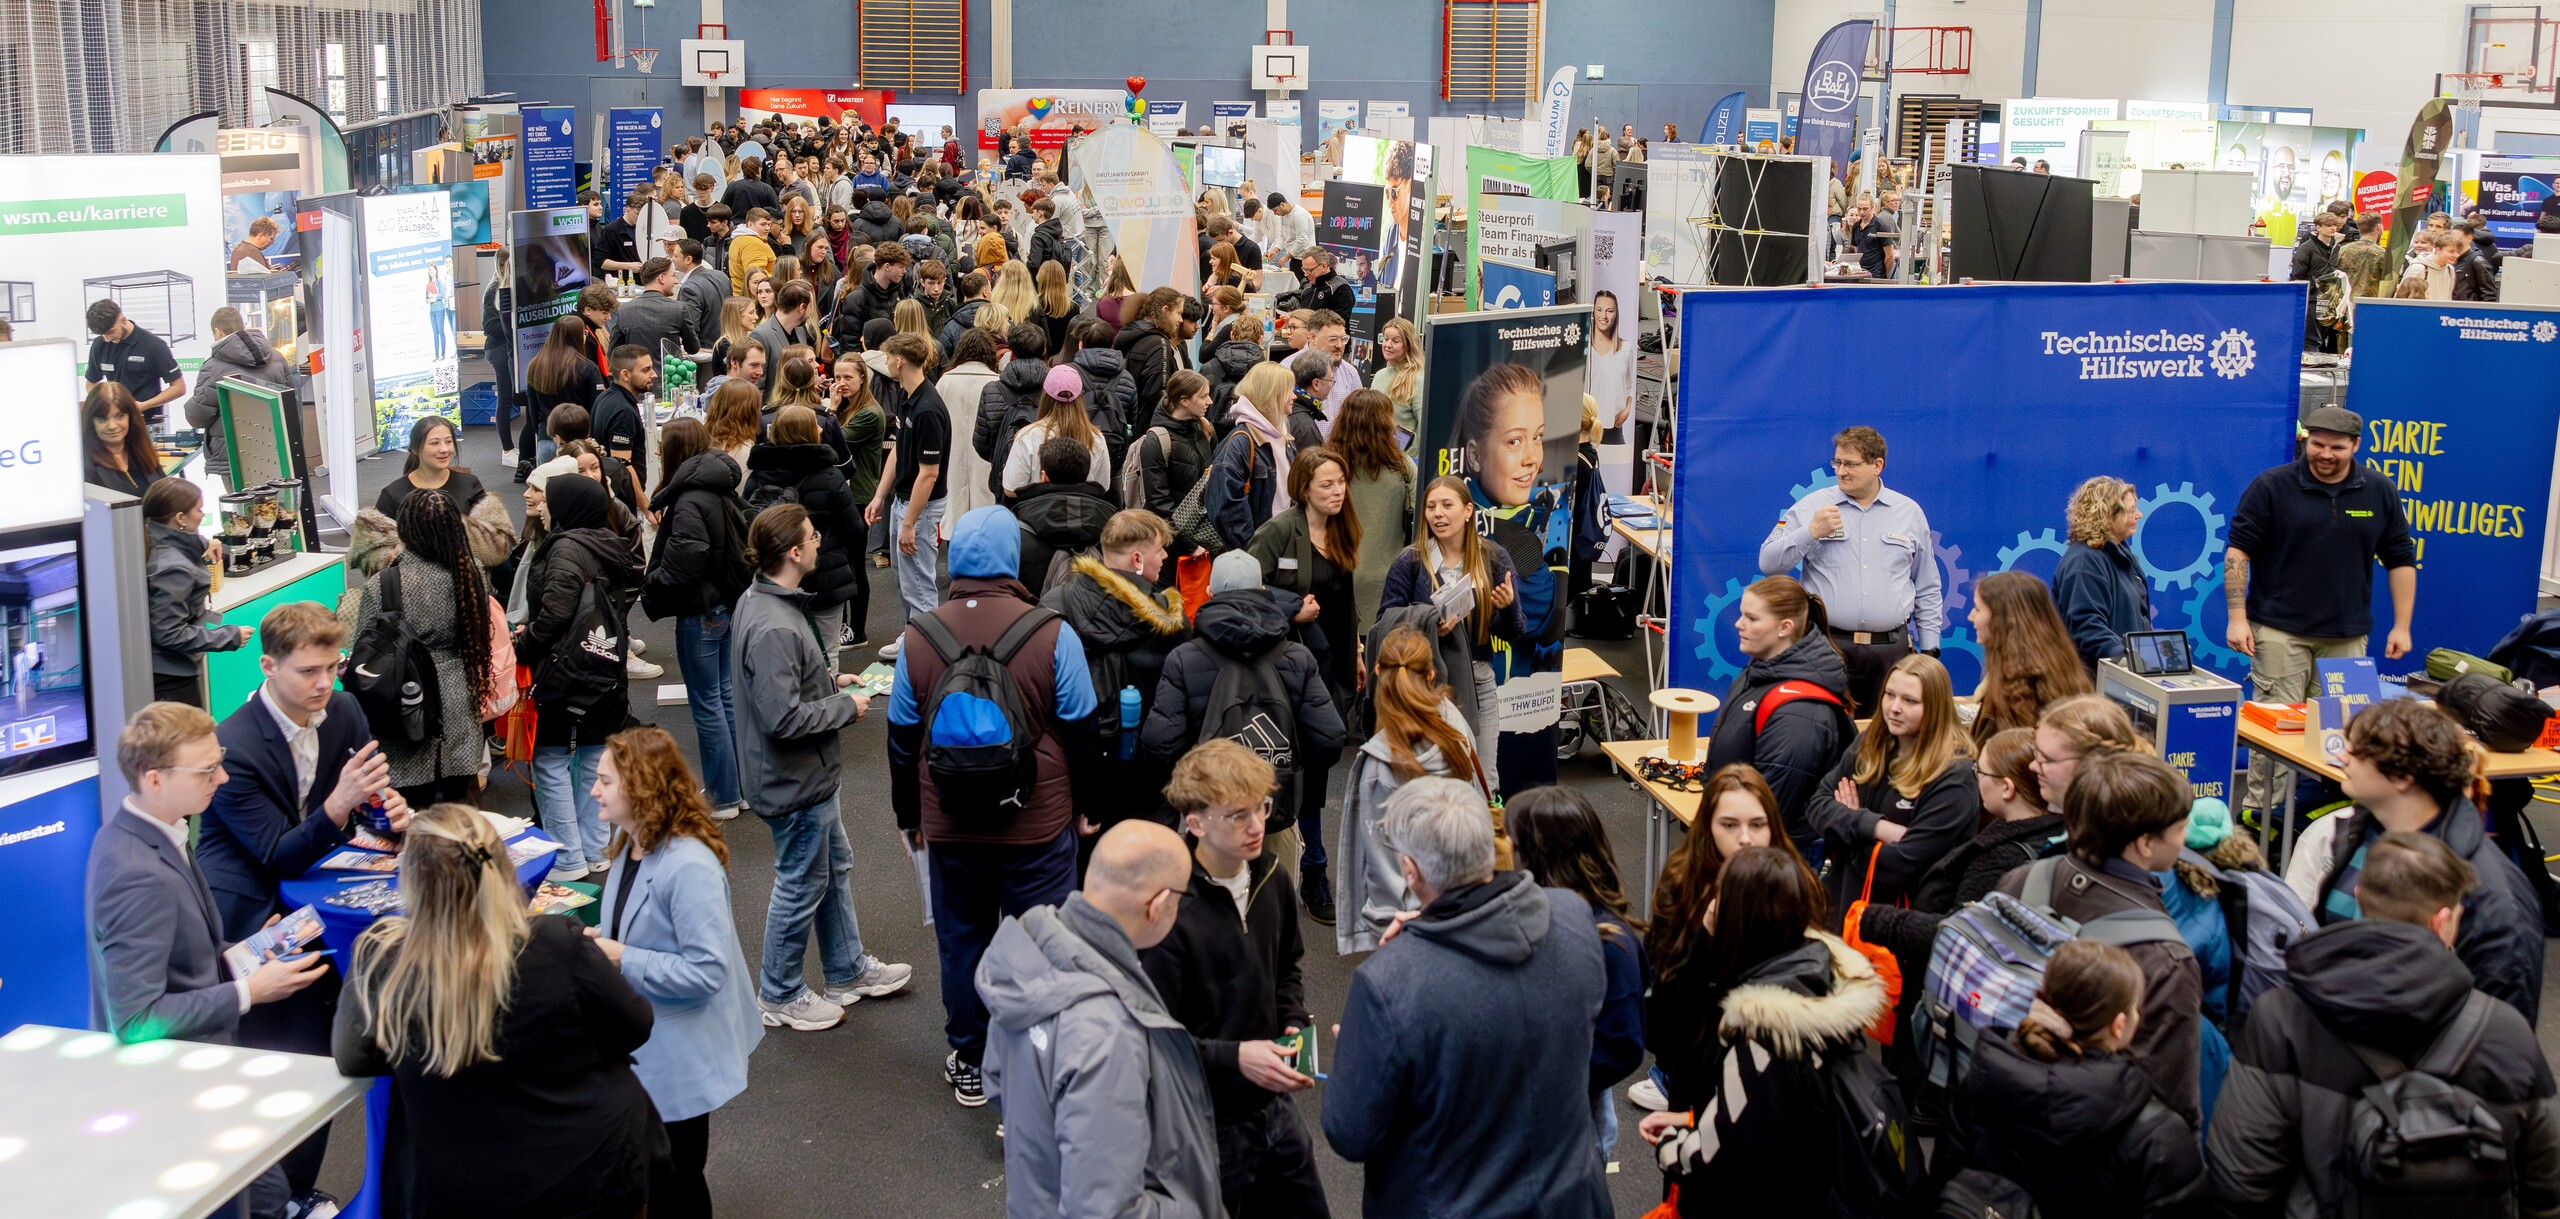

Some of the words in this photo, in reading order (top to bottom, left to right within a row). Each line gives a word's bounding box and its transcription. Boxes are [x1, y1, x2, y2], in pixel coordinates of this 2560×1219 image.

[1054, 98, 1120, 115] REINERY
[2013, 107, 2110, 116] ZUKUNFTSFORMER
[2131, 107, 2203, 120] ZUKUNFTSFORMER
[1547, 100, 1560, 159] EEBAUM
[1811, 118, 1825, 126] think
[1825, 119, 1850, 129] transport
[2013, 118, 2064, 126] GESUCHT!
[216, 132, 286, 152] BERG
[2357, 181, 2398, 196] AUSBILDUNG
[2481, 181, 2512, 192] Was
[2362, 192, 2395, 203] Physiotherapie
[2365, 200, 2394, 210] Ergotherapie
[3, 203, 168, 225] wsm.eu/karriere
[1478, 210, 1534, 227] Steuerprofi
[2492, 209, 2515, 217] Kampf
[452, 219, 472, 229] geben?
[558, 216, 582, 226] wsm
[1481, 226, 1508, 240] Team
[1481, 244, 1509, 256] mehr
[1511, 245, 1528, 258] als
[551, 298, 560, 306] mit
[560, 295, 577, 304] deiner
[518, 302, 578, 324] AUSBILDUNG
[2440, 315, 2530, 330] Technisches
[522, 330, 550, 341] Technisch
[1498, 325, 1561, 340] Technisches
[2459, 327, 2529, 342] Hilfswerk
[522, 341, 546, 351] System
[1512, 337, 1561, 351] Hilfswerk
[2041, 329, 2205, 354] Technisches
[2079, 355, 2204, 380] Hilfswerk
[2369, 418, 2448, 456] STARTE
[1438, 446, 1465, 477] BEI
[1475, 506, 1496, 538] EST
[2401, 498, 2526, 538] IWILLIGES
[1514, 690, 1544, 701] FREIWILLIGES
[1544, 687, 1555, 696] JAHR
[1511, 700, 1531, 712] THW
[1531, 695, 1555, 708] BUFDI
[2168, 752, 2196, 768] STARTE
